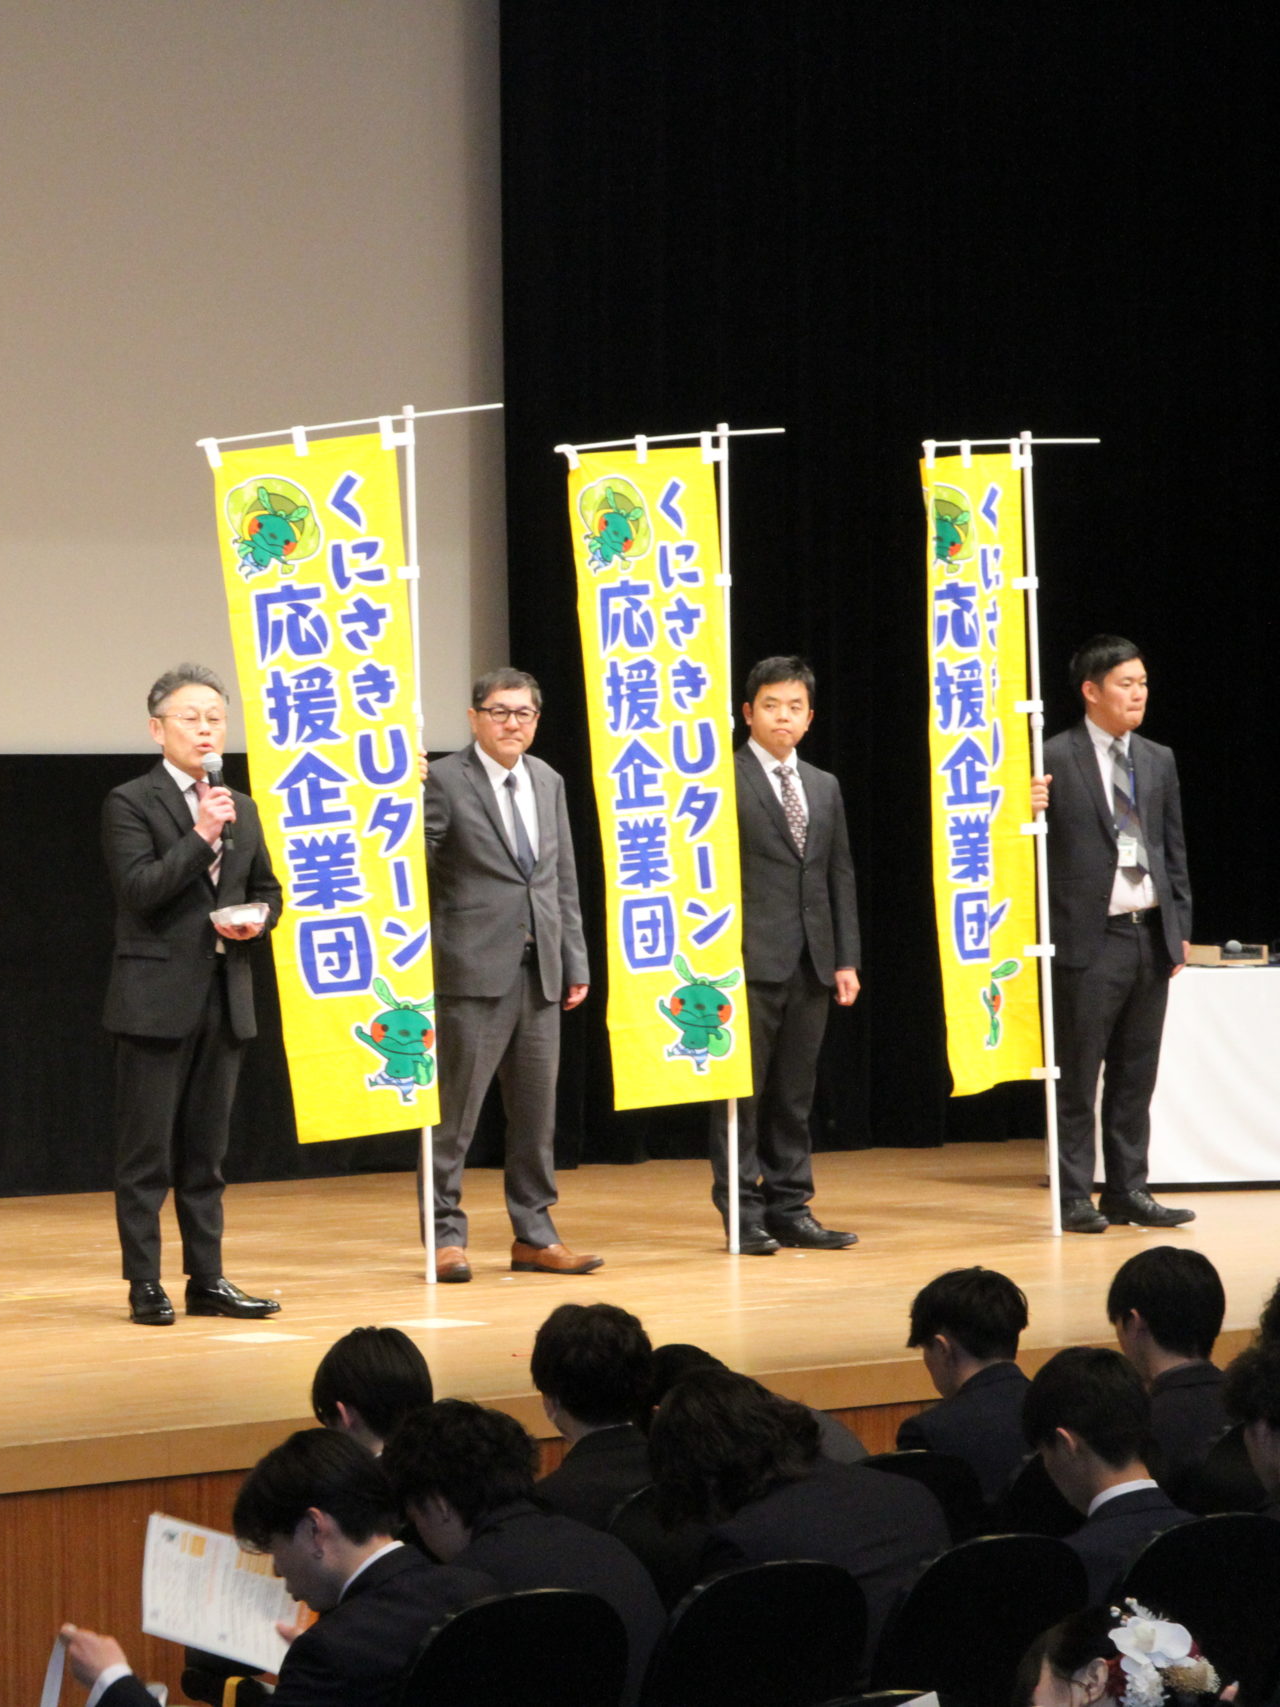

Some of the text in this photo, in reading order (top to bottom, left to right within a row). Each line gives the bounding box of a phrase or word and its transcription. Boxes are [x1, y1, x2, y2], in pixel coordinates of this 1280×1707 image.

[255, 584, 373, 994] 応援企業団
[331, 475, 428, 966] くにさきUターン
[600, 580, 675, 969] 応援企業団
[660, 482, 729, 944] くにさきUターン
[933, 581, 992, 960] 応援企業団
